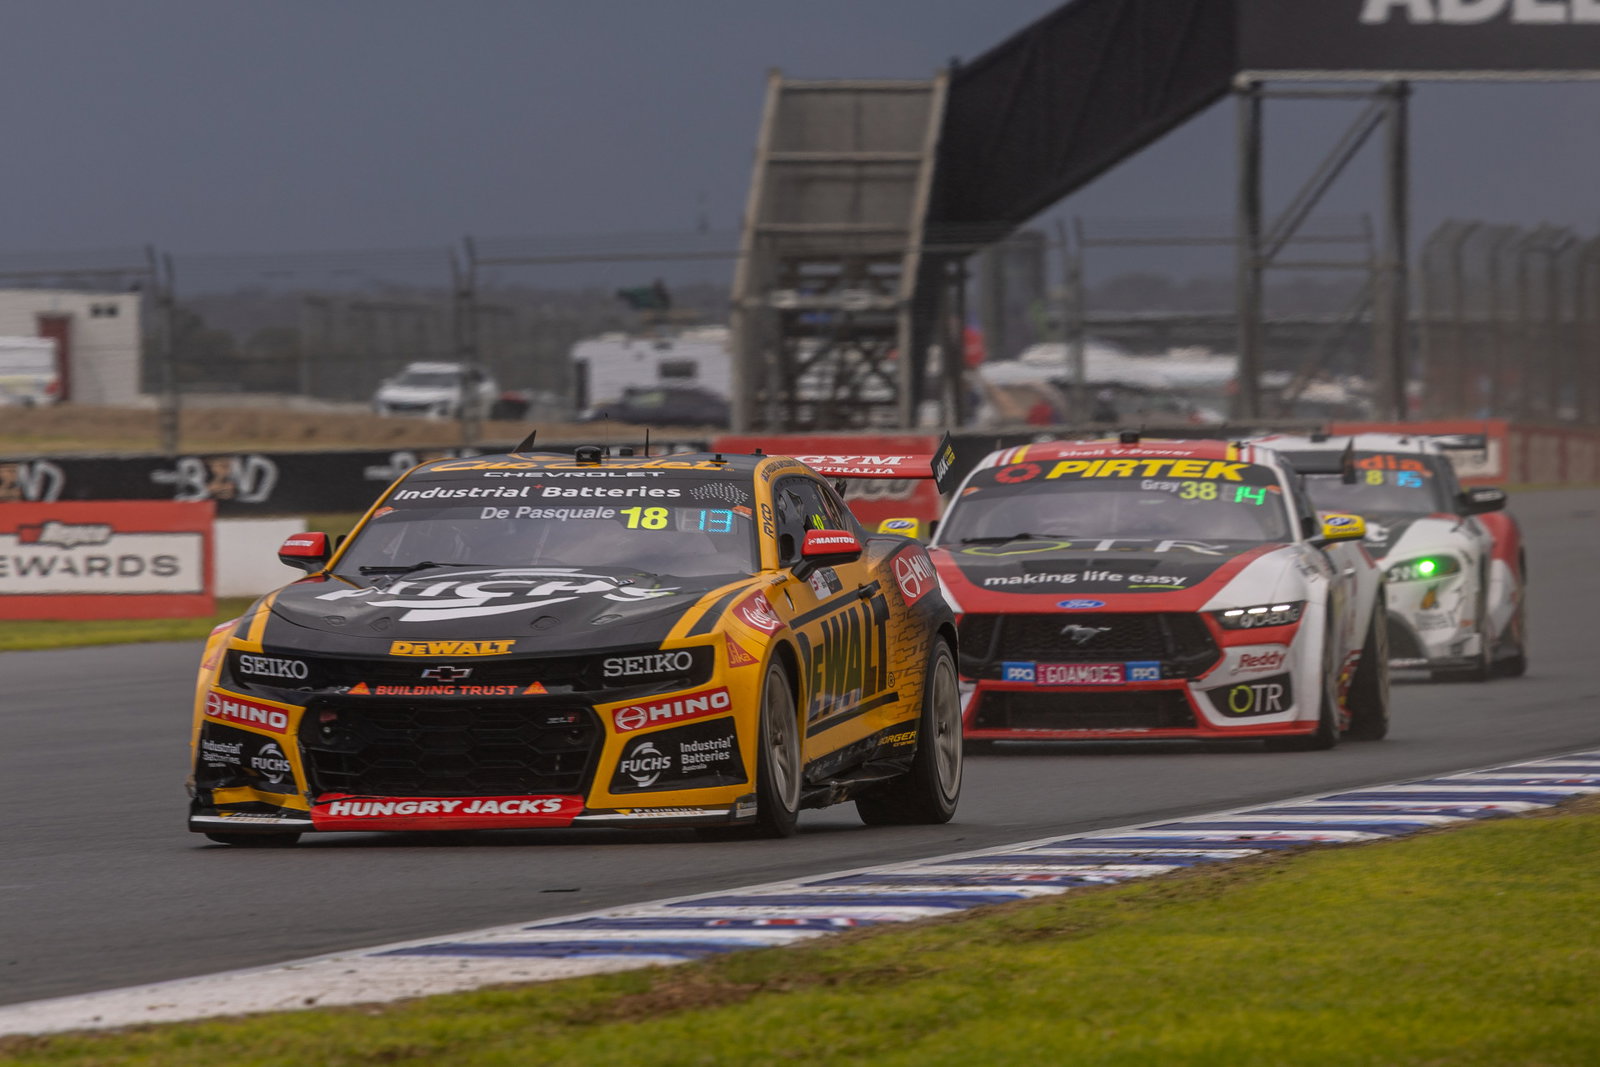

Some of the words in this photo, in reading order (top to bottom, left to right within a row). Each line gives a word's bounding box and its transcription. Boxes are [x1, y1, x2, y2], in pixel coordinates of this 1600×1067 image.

[795, 456, 905, 465] GYM
[1045, 459, 1251, 481] PIRTEK
[394, 486, 530, 500] Industrial
[542, 486, 682, 498] Batteries
[1141, 480, 1180, 492] Gray
[1179, 481, 1217, 501] 38
[1234, 486, 1267, 506] 14
[480, 507, 510, 519] De
[515, 506, 615, 521] Pasquale
[620, 506, 669, 530] 18
[698, 508, 734, 533] 13
[761, 503, 776, 539] RYCO
[816, 537, 855, 545] MANITOU
[984, 573, 1077, 586] making
[1083, 571, 1123, 583] life
[1128, 574, 1188, 586] easy
[389, 640, 516, 656] DEWALT
[603, 651, 693, 677] SEIKO
[796, 594, 890, 722] DEWALT
[1239, 652, 1287, 668] Reddy
[240, 655, 308, 680] SEIKO
[1008, 668, 1034, 680] PPQ
[1132, 668, 1159, 680] PPQ
[375, 685, 455, 695] BUILDING
[457, 685, 519, 695] TRUST
[649, 691, 730, 720] HINO
[1228, 684, 1283, 713] OTR
[221, 701, 288, 729] HINO
[680, 738, 731, 752] Industrial
[879, 731, 917, 745] ORGER
[202, 740, 241, 754] Industrial
[251, 757, 290, 772] FUCHS
[620, 756, 671, 773] FUCHS
[681, 751, 730, 764] Batteries
[328, 800, 462, 816] HUNGRY
[462, 798, 562, 814] JACK'S
